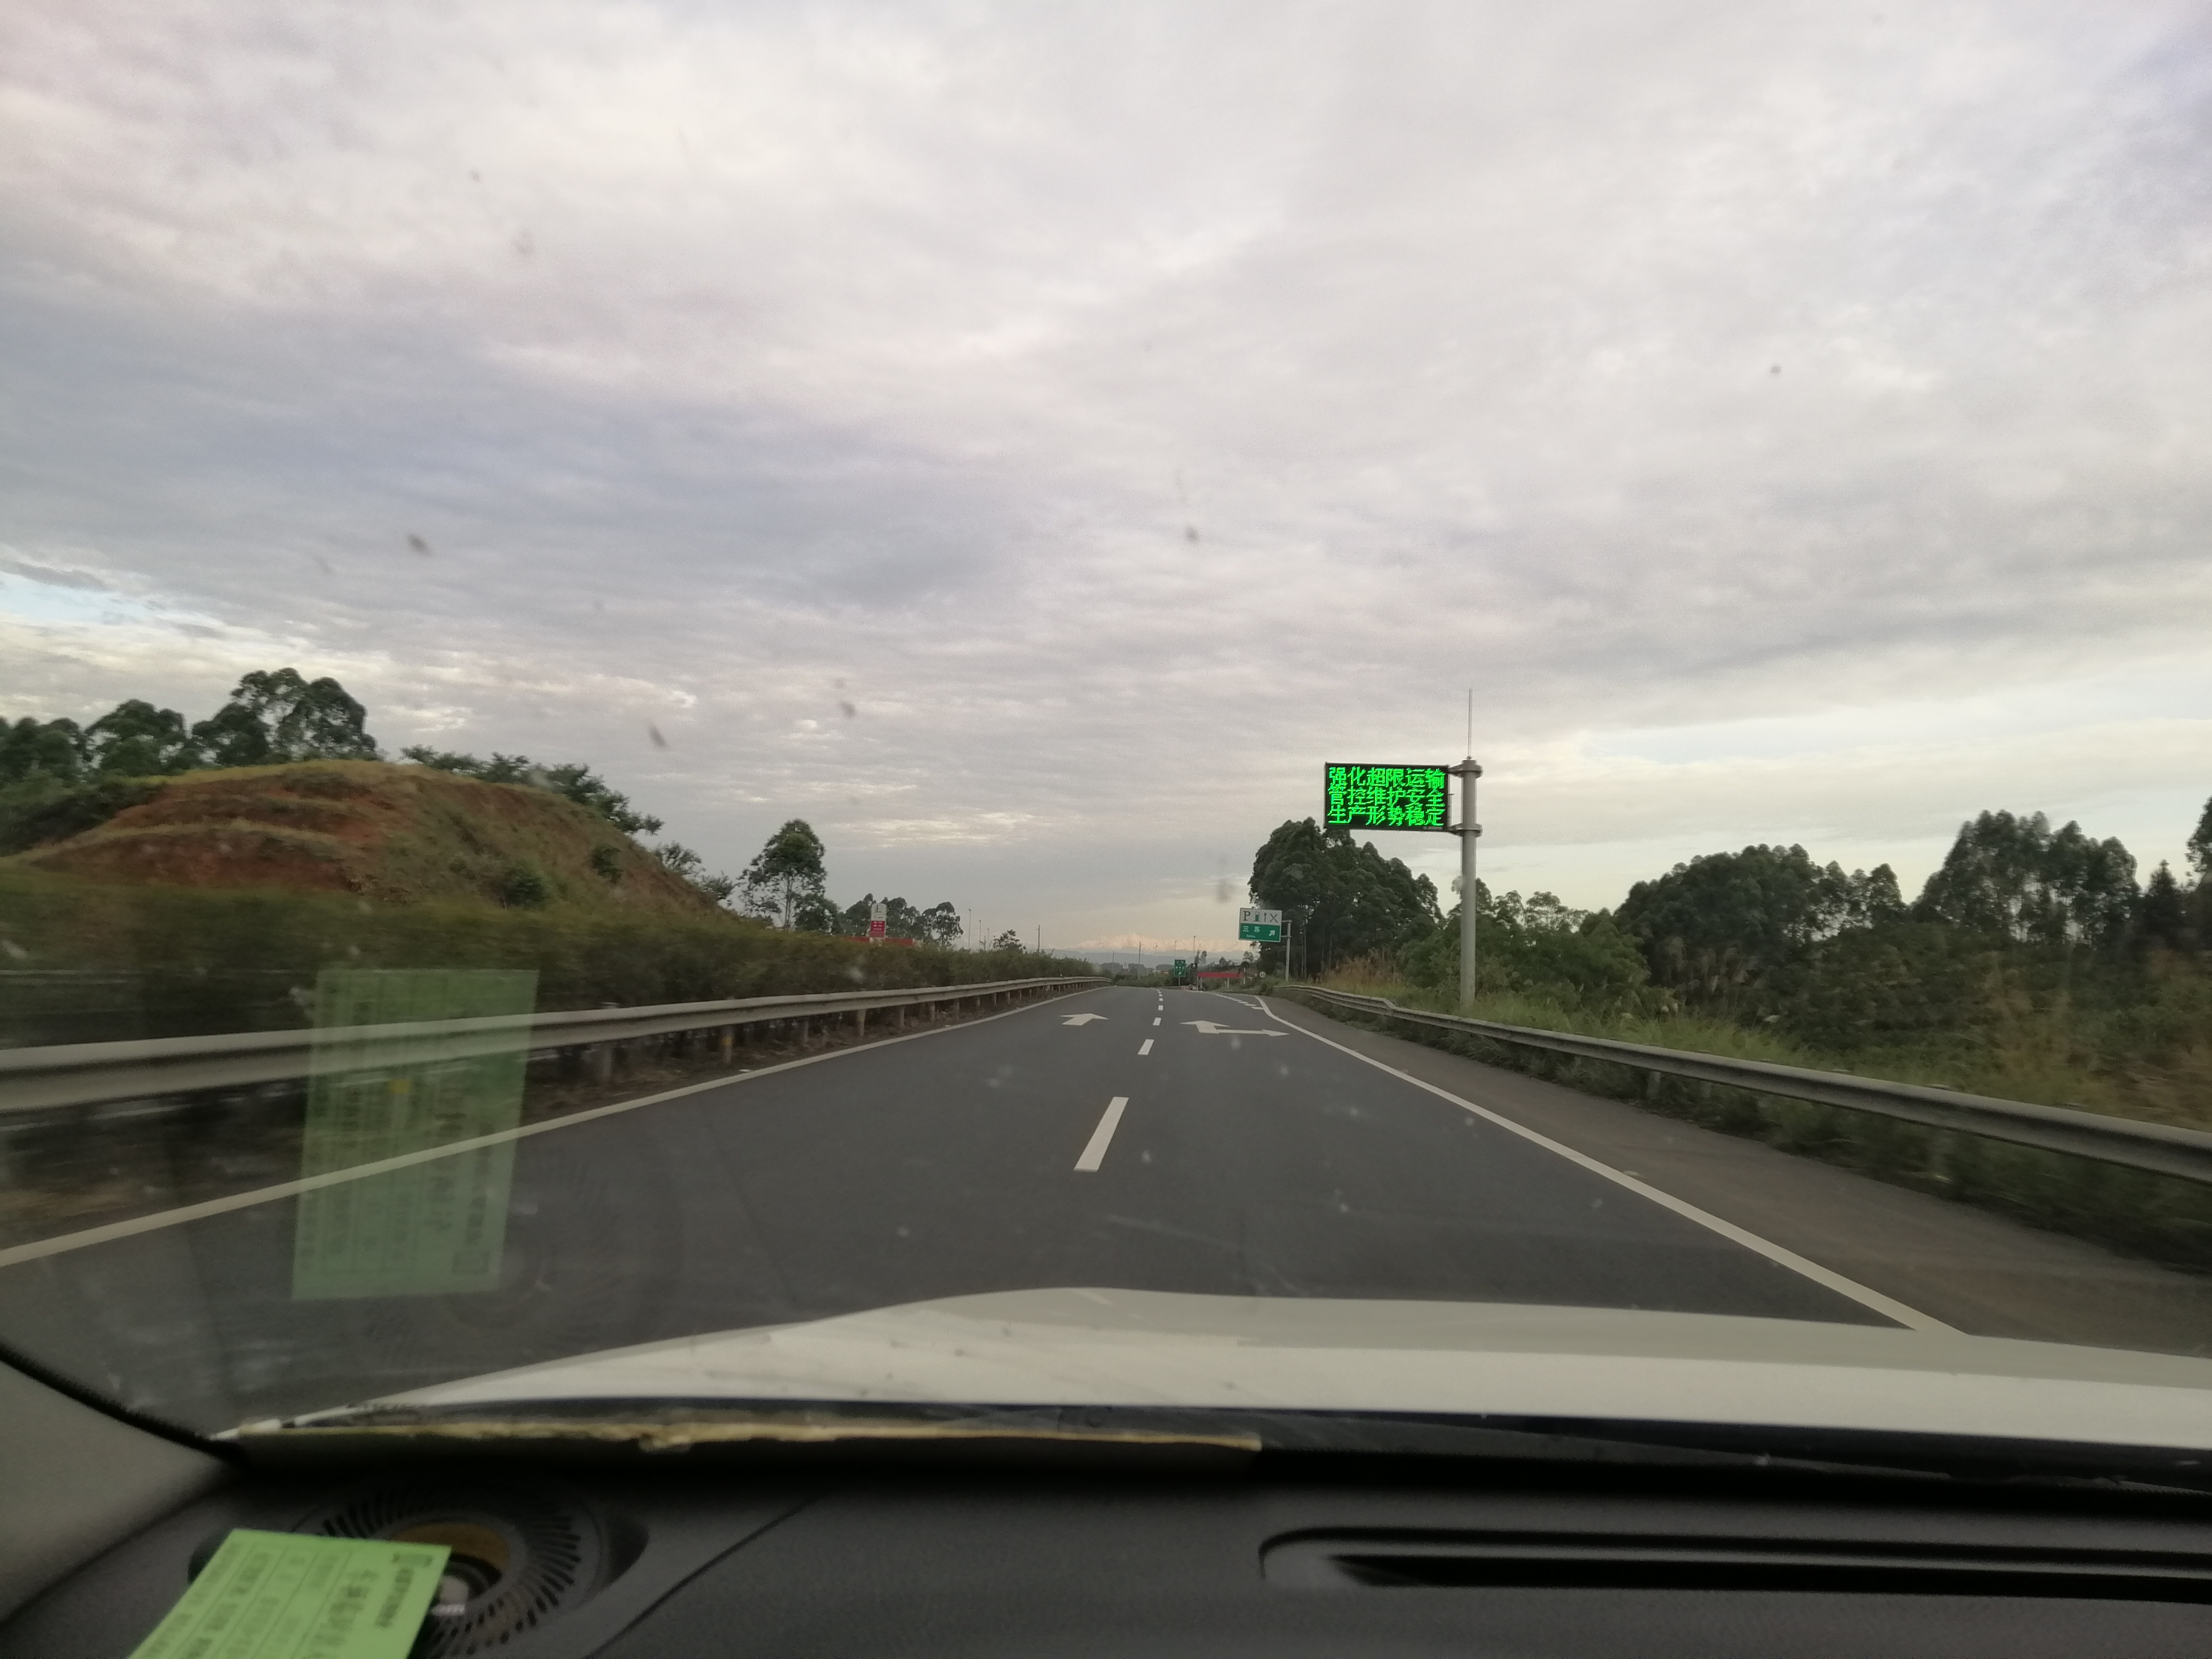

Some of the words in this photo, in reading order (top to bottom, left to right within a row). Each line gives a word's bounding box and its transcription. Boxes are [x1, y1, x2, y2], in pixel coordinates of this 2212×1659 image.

[1328, 767, 1446, 789] 强化超限运输
[1328, 784, 1445, 807] 管控维护安全
[1327, 805, 1445, 826] 生产形势稳定
[1243, 911, 1250, 921] P
